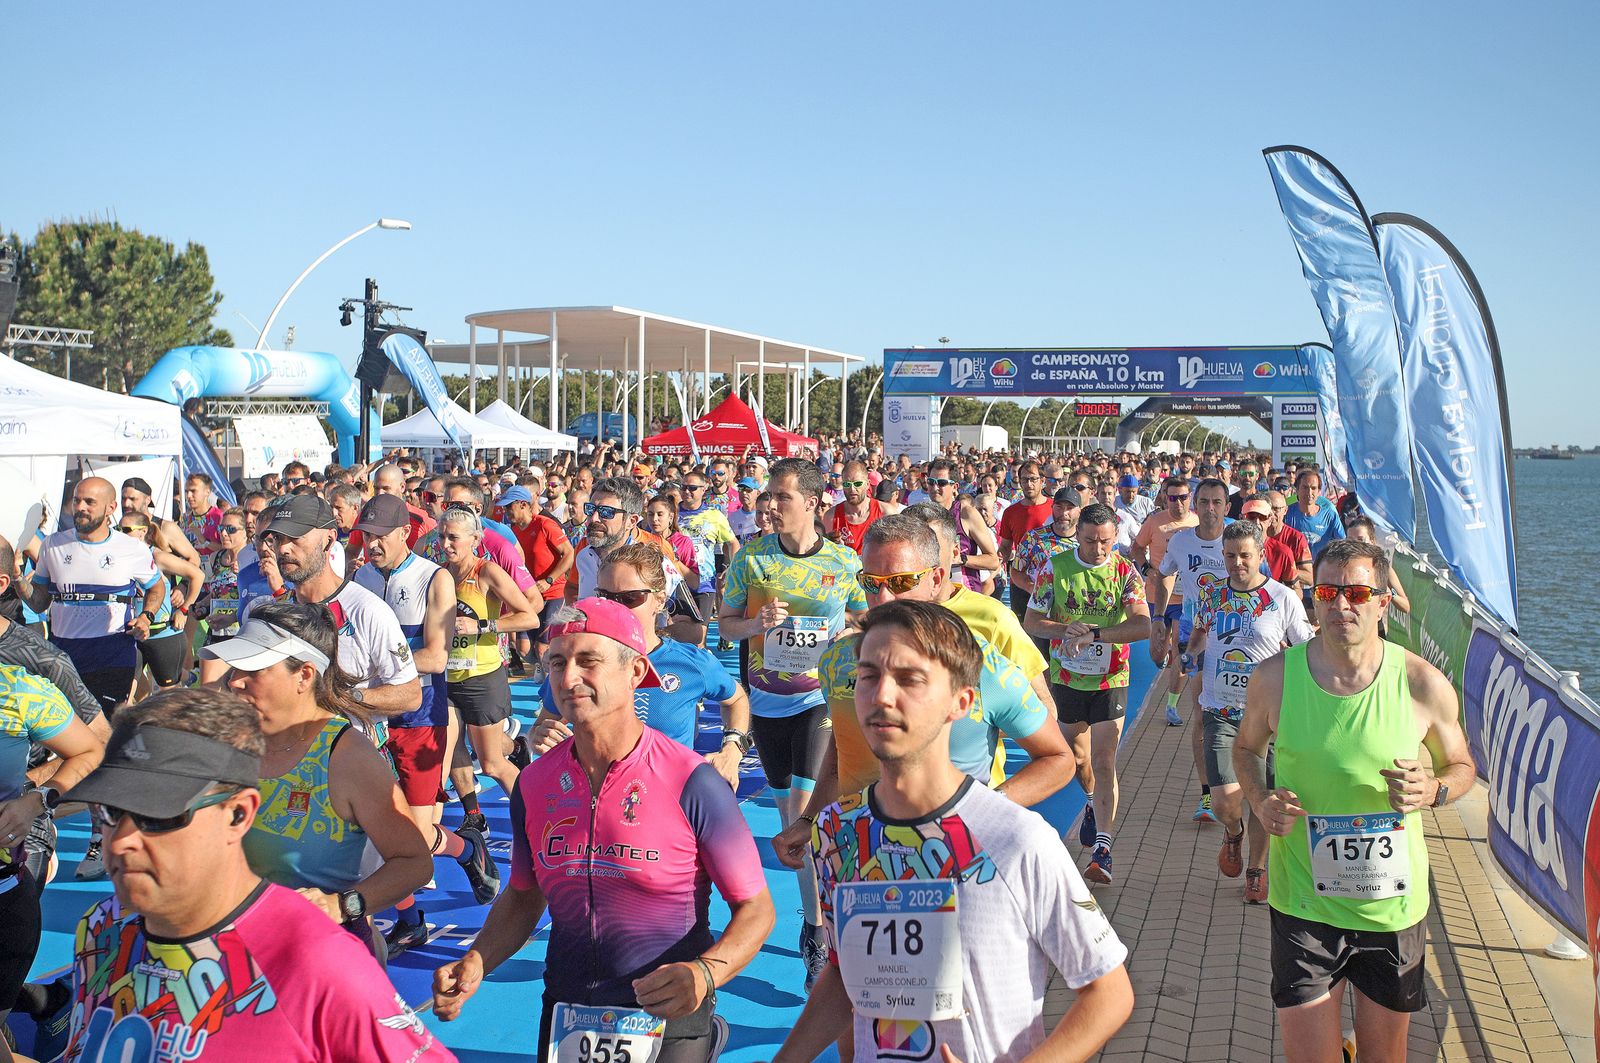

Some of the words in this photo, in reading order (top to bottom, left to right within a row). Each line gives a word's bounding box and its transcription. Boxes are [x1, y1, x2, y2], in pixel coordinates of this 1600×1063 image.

[1031, 354, 1130, 366] CAMPEONATO
[949, 357, 973, 388] 10
[1031, 369, 1046, 380] de
[1049, 367, 1098, 380] ESPAÑA
[1106, 366, 1129, 382] 10
[1135, 365, 1165, 382] km
[1178, 356, 1203, 388] 10
[1203, 362, 1244, 375] HUELVA
[993, 378, 1014, 386] WiHu
[1095, 382, 1129, 390] Absoluto
[1130, 383, 1136, 391] y
[1137, 382, 1164, 390] Master
[647, 445, 683, 454] SPORT
[696, 445, 735, 454] ANIACS
[1187, 553, 1202, 573] 10
[805, 620, 822, 628] 2023
[776, 630, 818, 648] 1533
[1326, 835, 1394, 861] 1573
[565, 867, 626, 879] CARTAYA
[1337, 872, 1360, 880] RAMOS
[842, 888, 856, 916] 10
[855, 892, 881, 905] HUELVA
[908, 889, 943, 907] 2023
[861, 919, 924, 956] 718
[878, 965, 909, 974] MANUEL
[864, 977, 894, 986] CAMPOS
[895, 977, 928, 986] CONEJO
[563, 1008, 577, 1031] 10
[576, 1014, 600, 1024] HUELVA
[621, 1016, 653, 1031] 2023
[578, 1036, 632, 1063] 955
